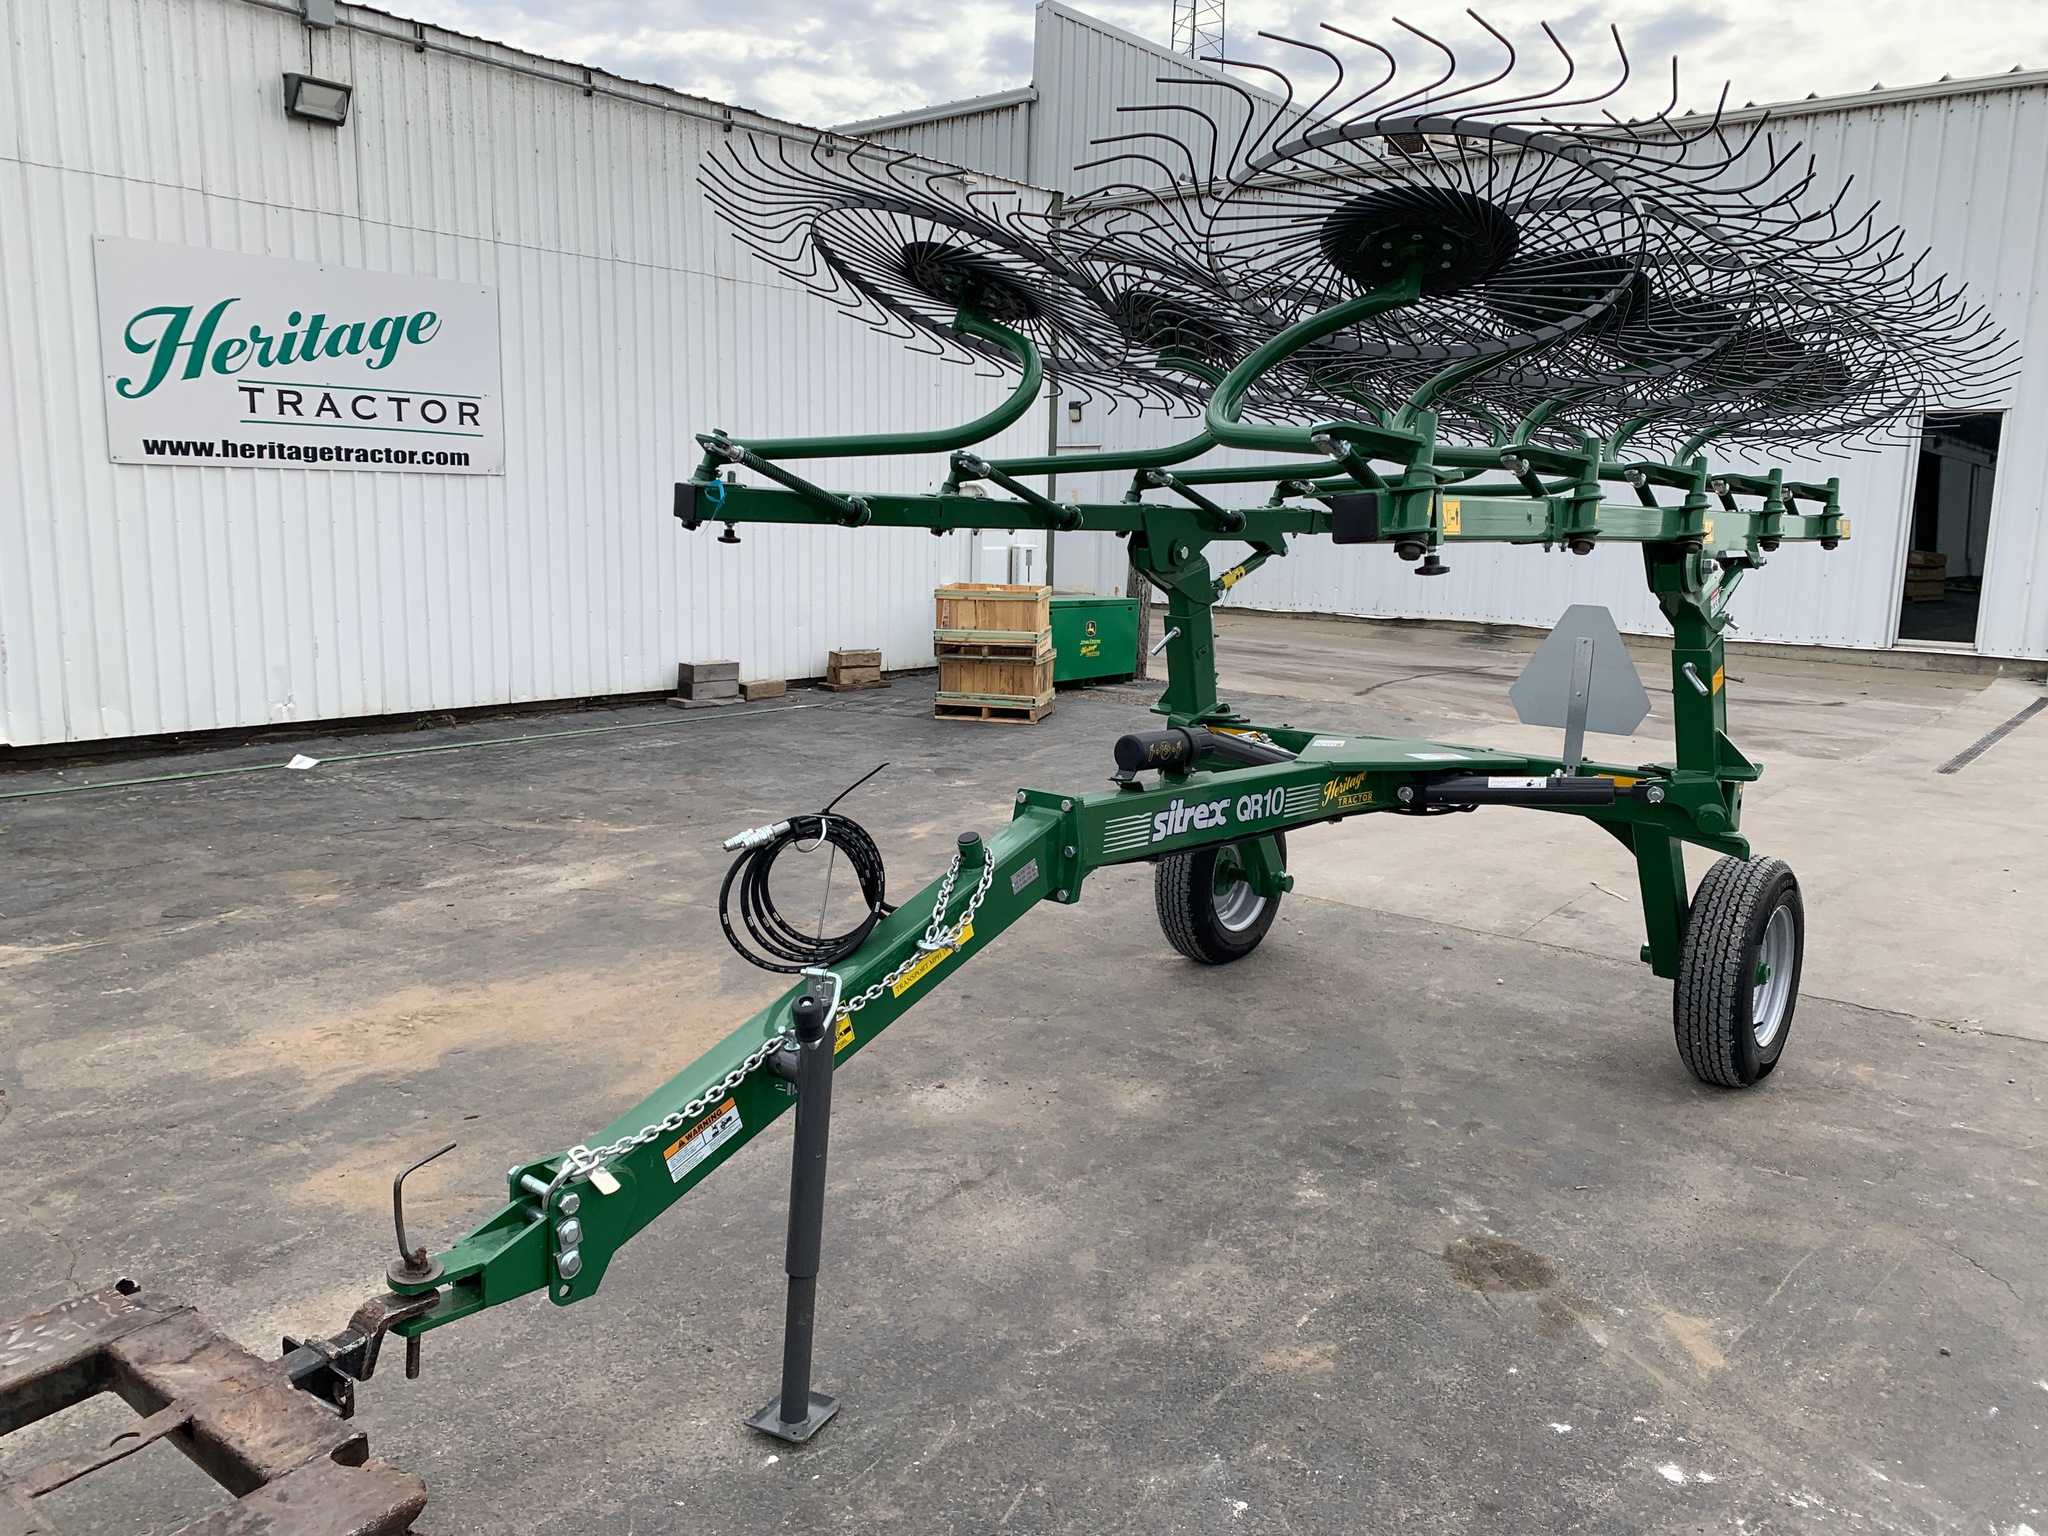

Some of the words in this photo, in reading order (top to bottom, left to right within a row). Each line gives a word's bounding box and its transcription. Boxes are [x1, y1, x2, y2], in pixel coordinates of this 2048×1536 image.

[116, 298, 442, 398] Heritage
[238, 386, 481, 427] TRACTOR
[143, 439, 470, 466] www.heritagetractor.com
[1321, 770, 1368, 807] Heritage
[1337, 793, 1373, 806] TRACTOR
[1152, 798, 1231, 842] sitrex
[1236, 786, 1285, 822] QR10
[895, 964, 929, 992] TRANSPORT
[929, 952, 943, 966] MPH
[685, 1109, 723, 1140] WARNING
